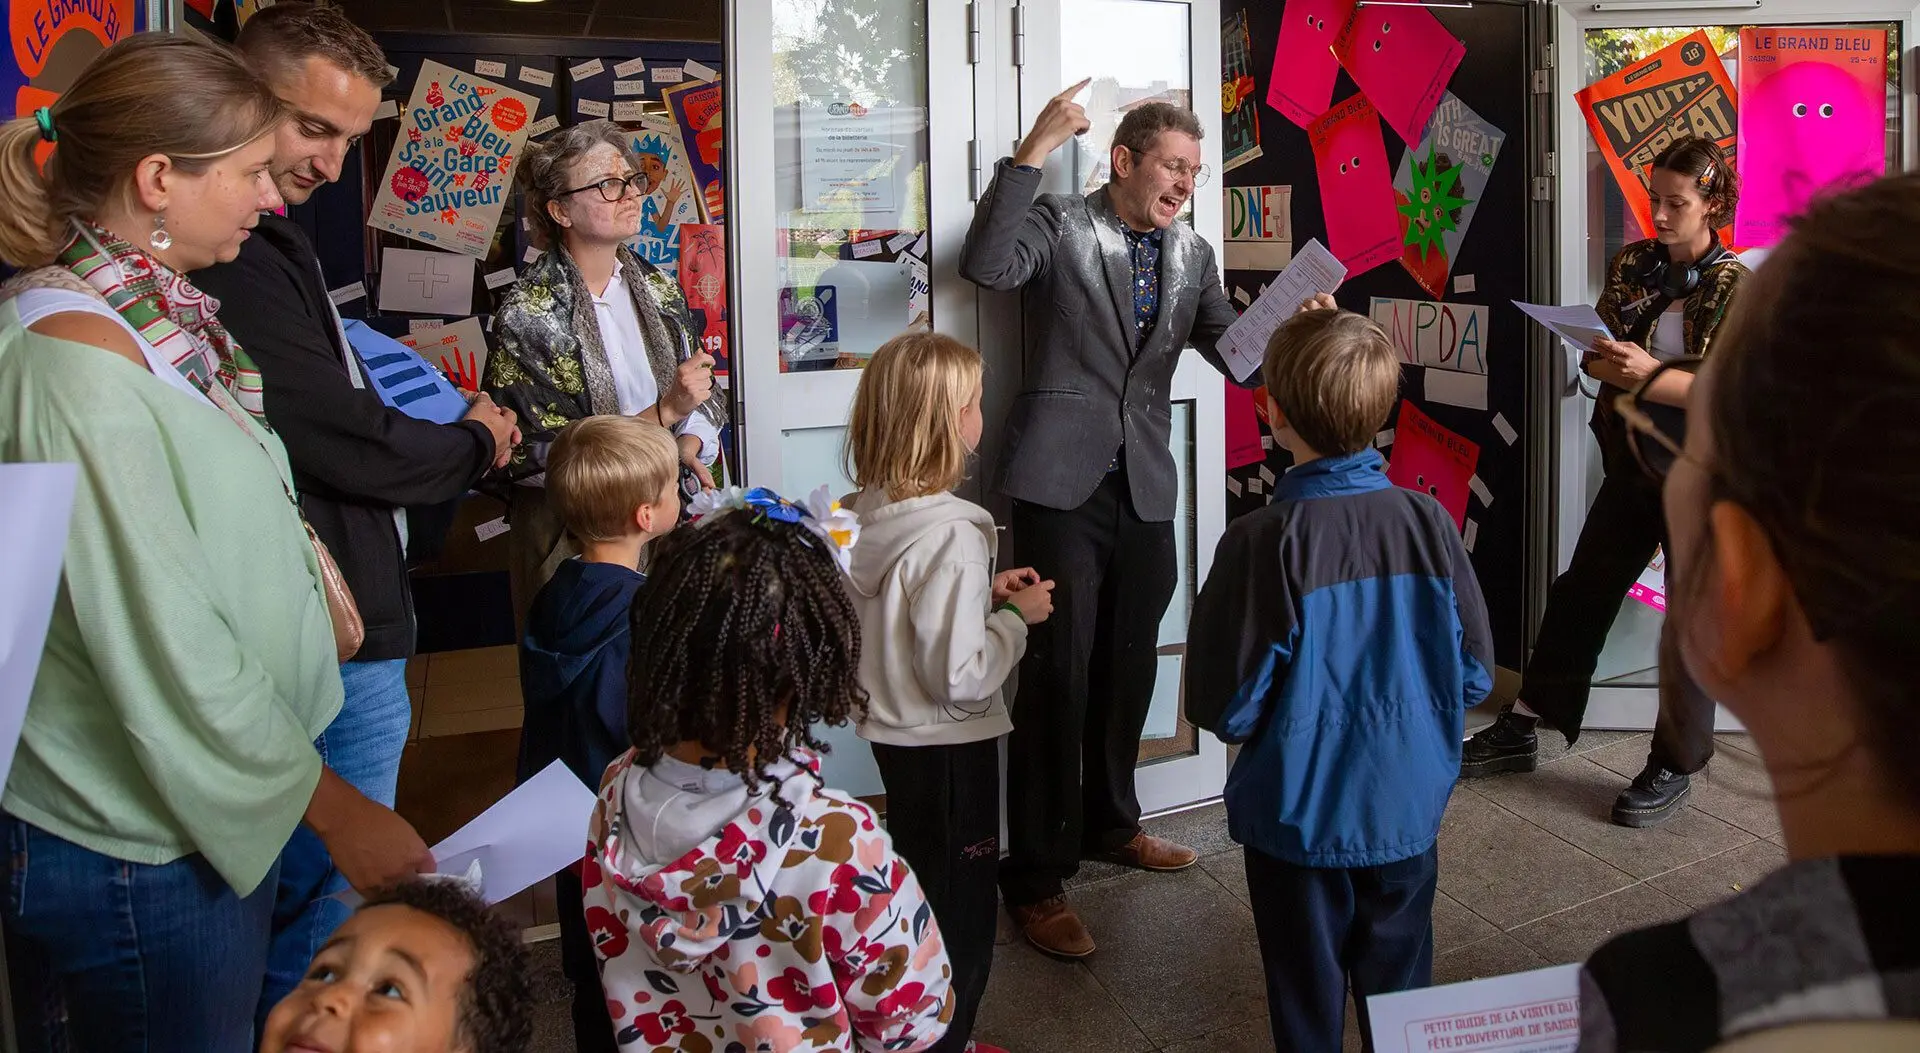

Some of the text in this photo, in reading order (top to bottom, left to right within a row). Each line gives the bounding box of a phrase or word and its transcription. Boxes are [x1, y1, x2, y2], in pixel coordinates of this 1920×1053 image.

[26, 8, 49, 64] LE
[1755, 36, 1871, 51] LE GRAND BLEU
[1747, 55, 1777, 63] SAISON
[448, 74, 468, 95] Le
[413, 86, 483, 132] Grand
[696, 115, 705, 127] LE
[1600, 76, 1707, 144] YOUTH
[462, 115, 512, 159] Bleu
[1437, 125, 1451, 147] IS
[1629, 87, 1733, 166] GREAT
[424, 136, 444, 149] à la
[1452, 127, 1502, 159] GREAT
[398, 140, 455, 193] Saint
[443, 147, 498, 174] Gare
[404, 184, 502, 216] Sauveur
[441, 334, 458, 346] 2022
[1423, 1021, 1453, 1035] PETIT
[1455, 1016, 1488, 1031] GUIDE
[1489, 1012, 1504, 1025] DE
[1505, 1010, 1519, 1023] LA
[1520, 1004, 1556, 1020] VISITE
[1557, 1001, 1573, 1013] DU
[1427, 1034, 1453, 1051] FÊTE
[1454, 1028, 1525, 1047] D'OUVERTURE
[1527, 1023, 1544, 1036] DE
